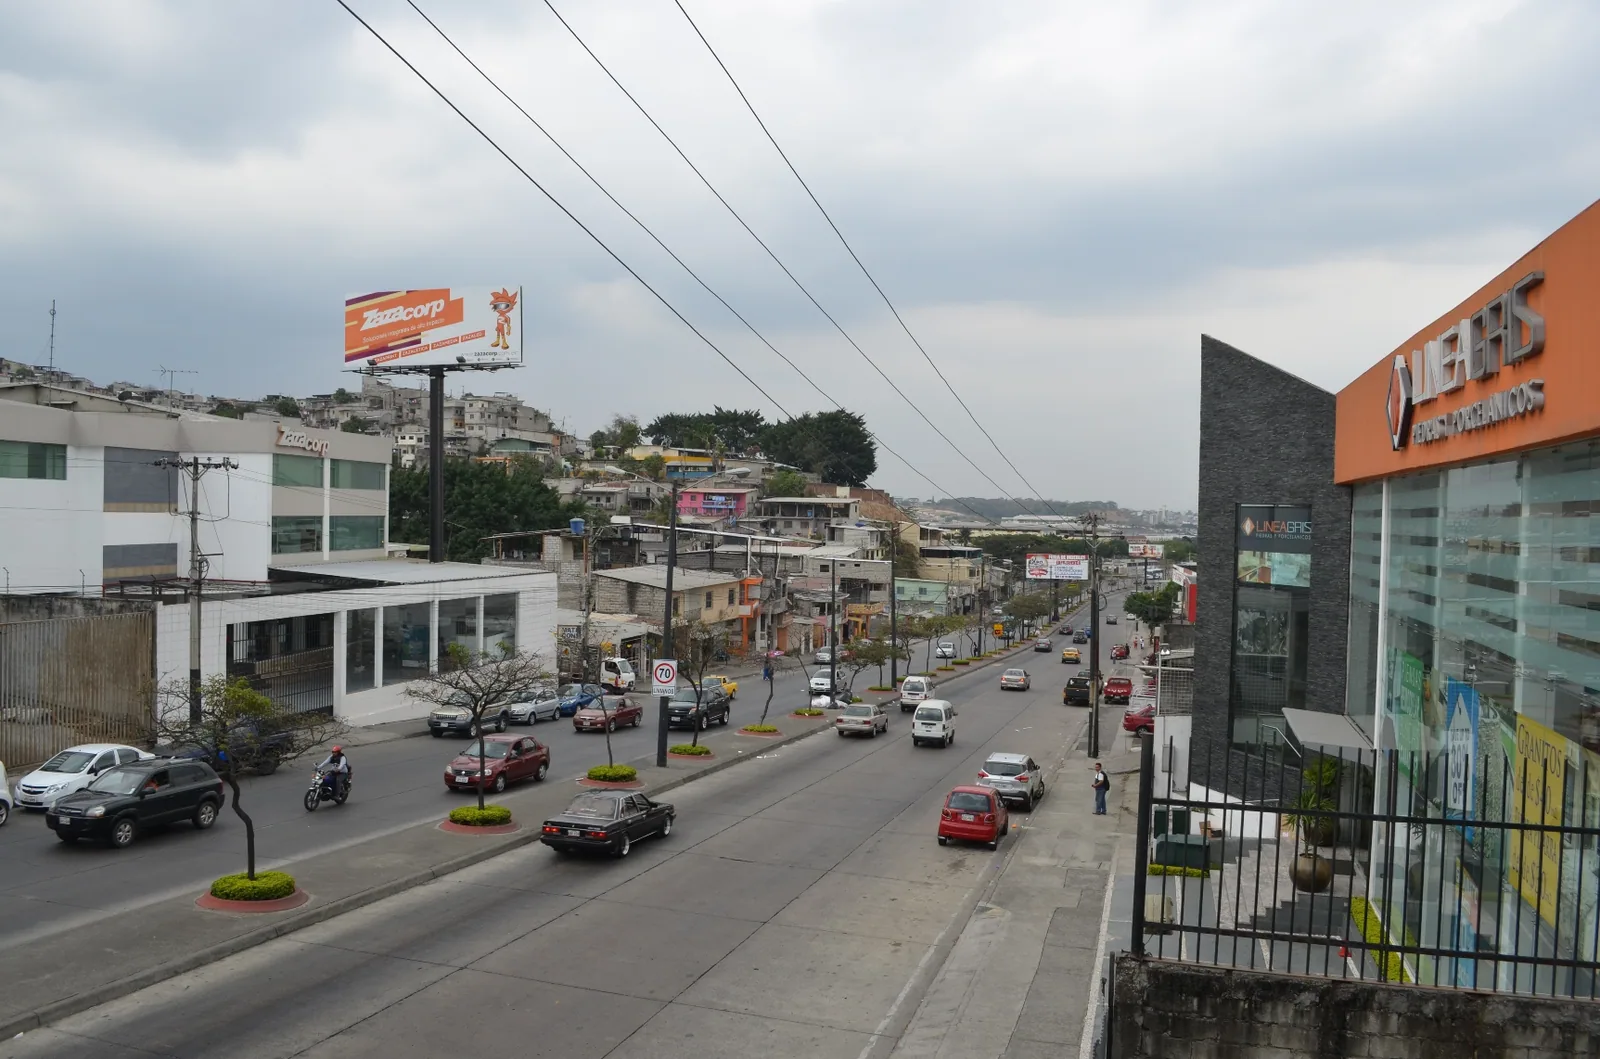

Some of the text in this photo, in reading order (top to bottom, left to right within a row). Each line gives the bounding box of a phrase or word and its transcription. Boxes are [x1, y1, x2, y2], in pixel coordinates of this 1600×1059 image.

[360, 299, 445, 332] Zazacorp
[1411, 271, 1545, 405] LINEAGRIS
[1256, 520, 1313, 534] LINEAGRIS
[658, 668, 671, 679] 70
[1517, 723, 1562, 779] GRANITOS
